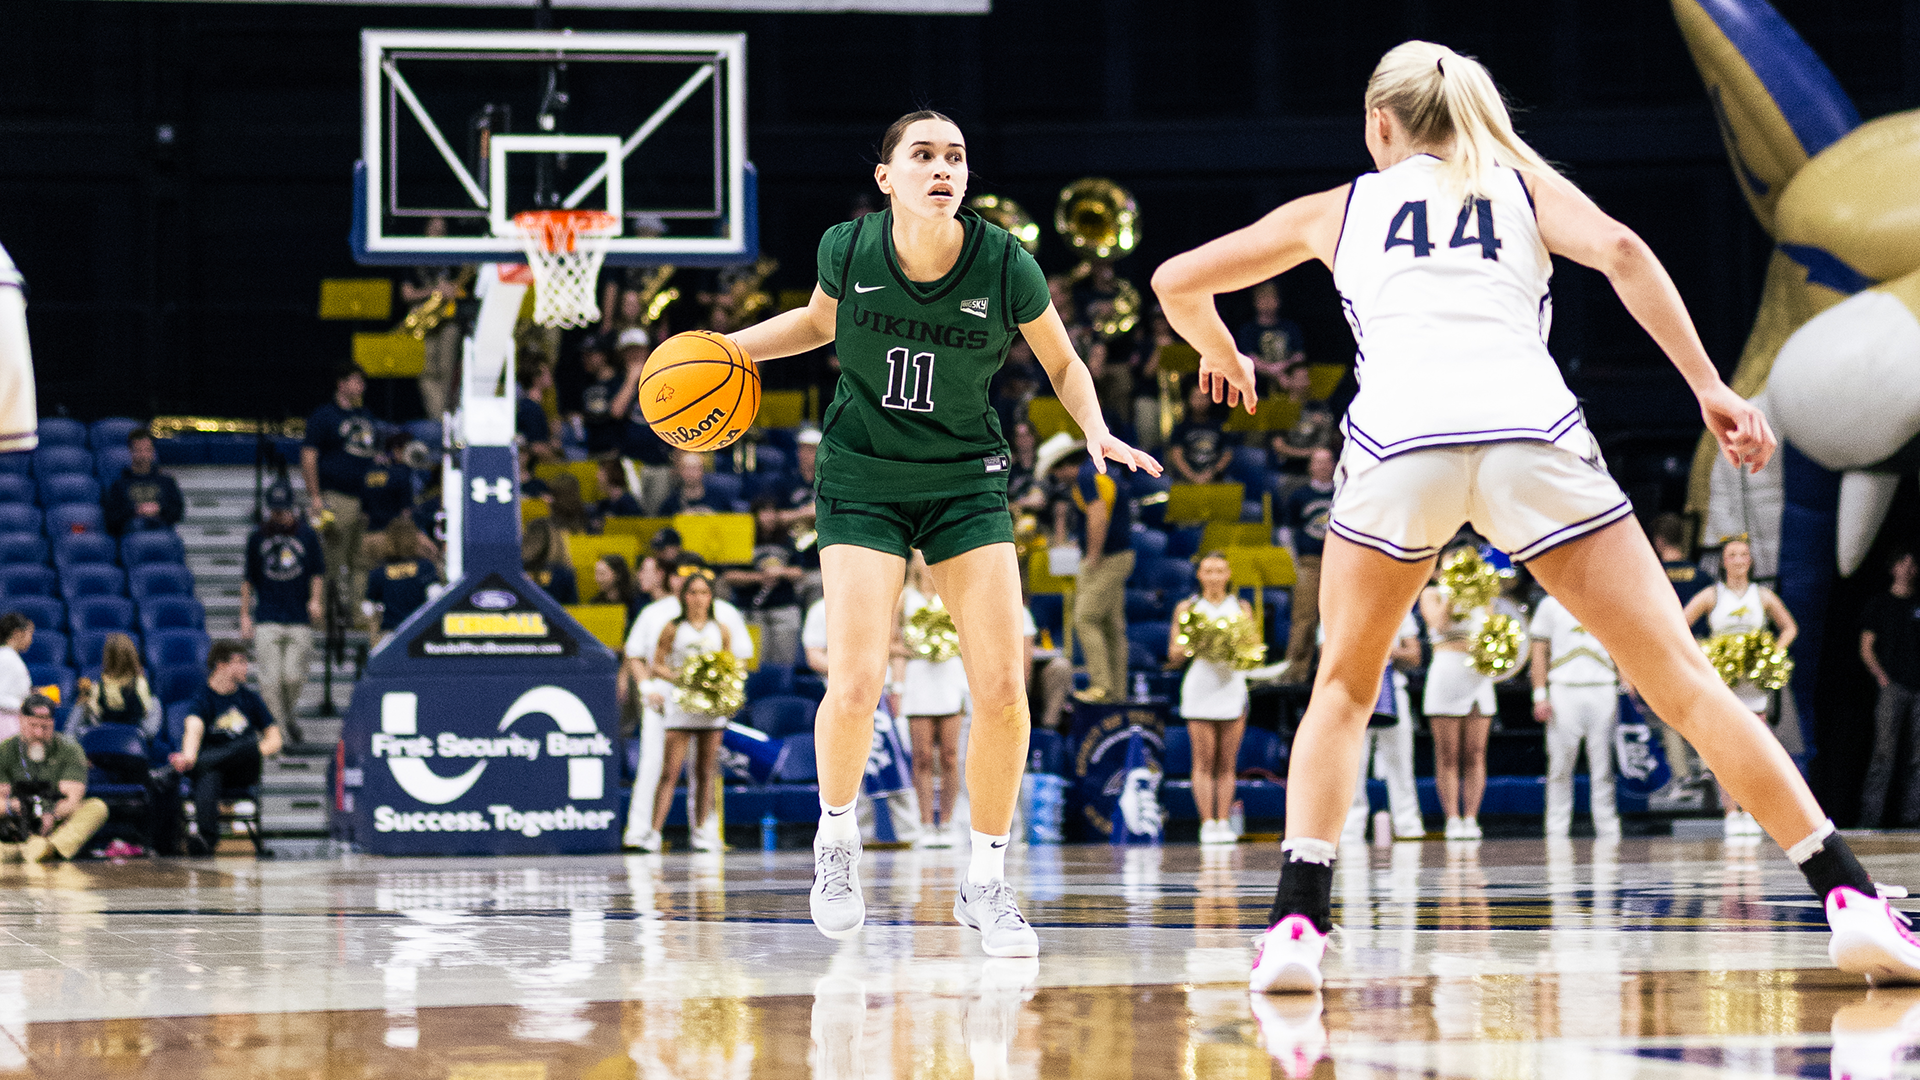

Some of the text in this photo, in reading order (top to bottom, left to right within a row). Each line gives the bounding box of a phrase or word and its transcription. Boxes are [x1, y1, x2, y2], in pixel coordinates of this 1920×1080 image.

[1384, 196, 1503, 262] 44
[853, 303, 989, 349] VIKINGS
[882, 346, 935, 412] 11
[443, 612, 548, 637] KENDALL
[371, 731, 613, 761] First Security Bank
[487, 804, 616, 838] Together
